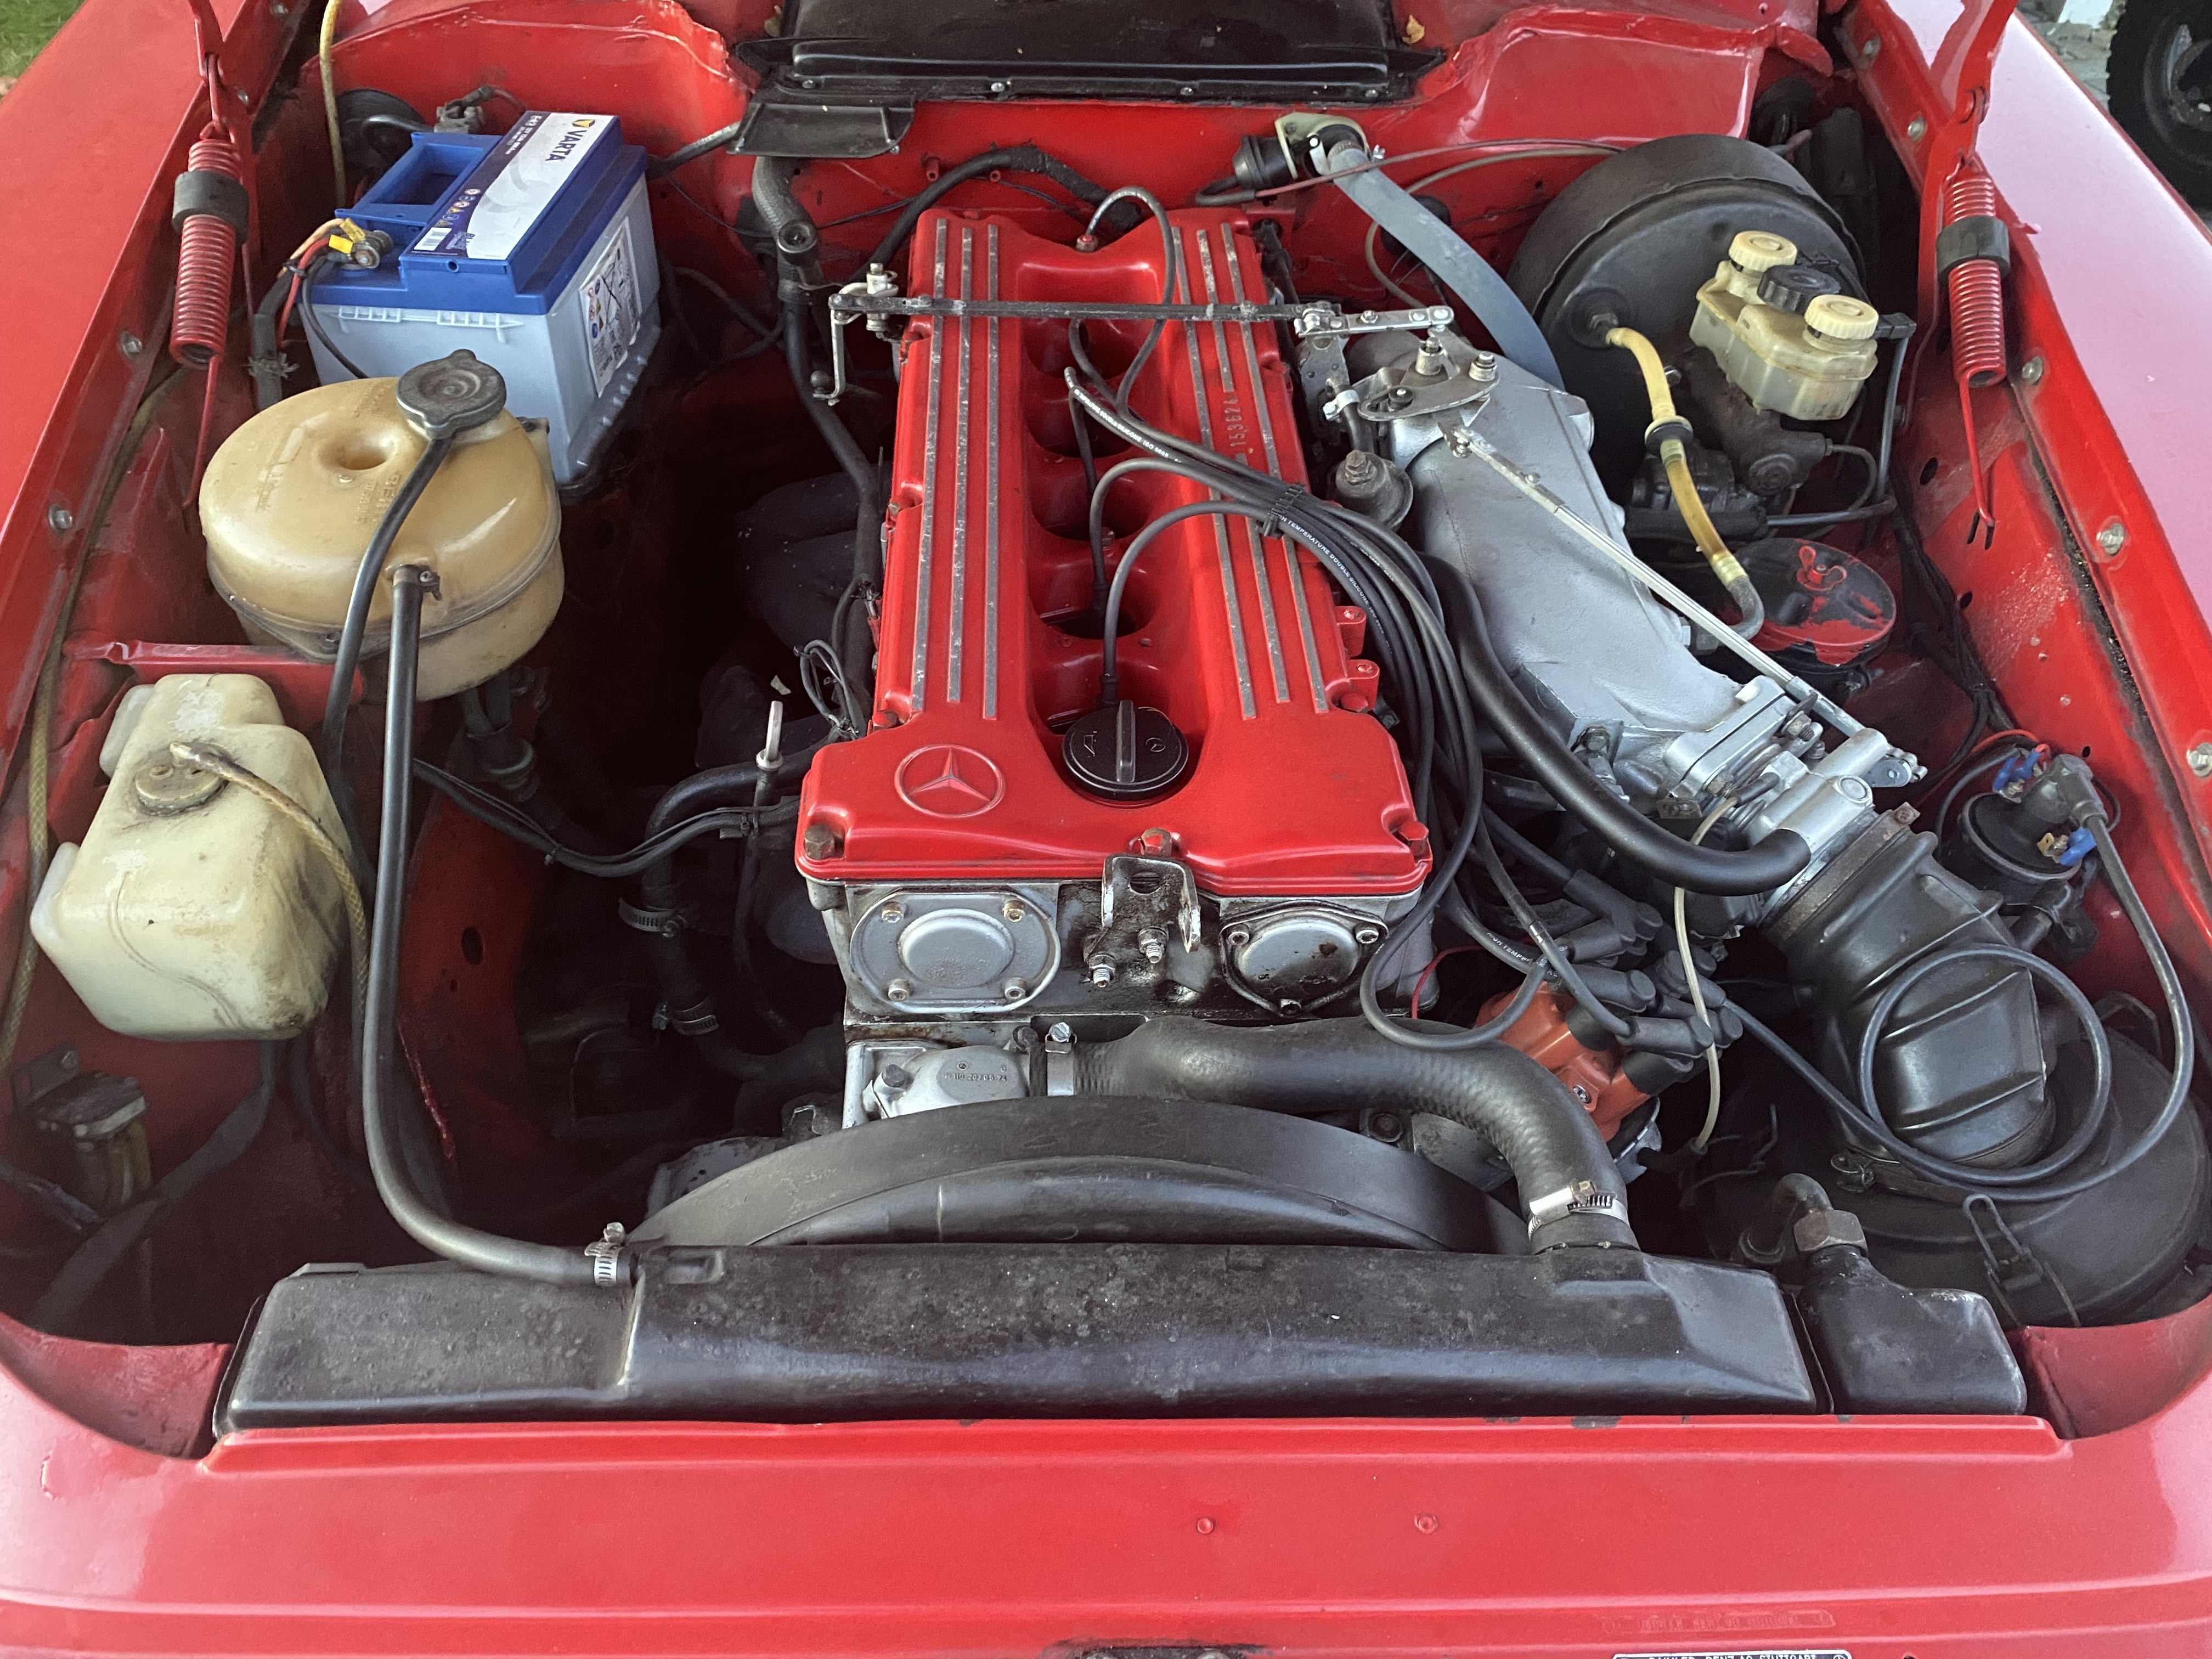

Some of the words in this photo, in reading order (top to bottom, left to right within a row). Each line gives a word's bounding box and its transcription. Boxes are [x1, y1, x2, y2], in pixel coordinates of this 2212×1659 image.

[545, 130, 587, 161] VARTA
[1288, 520, 1330, 555] TEMPERATURE
[1329, 554, 1351, 577] DOUBLE
